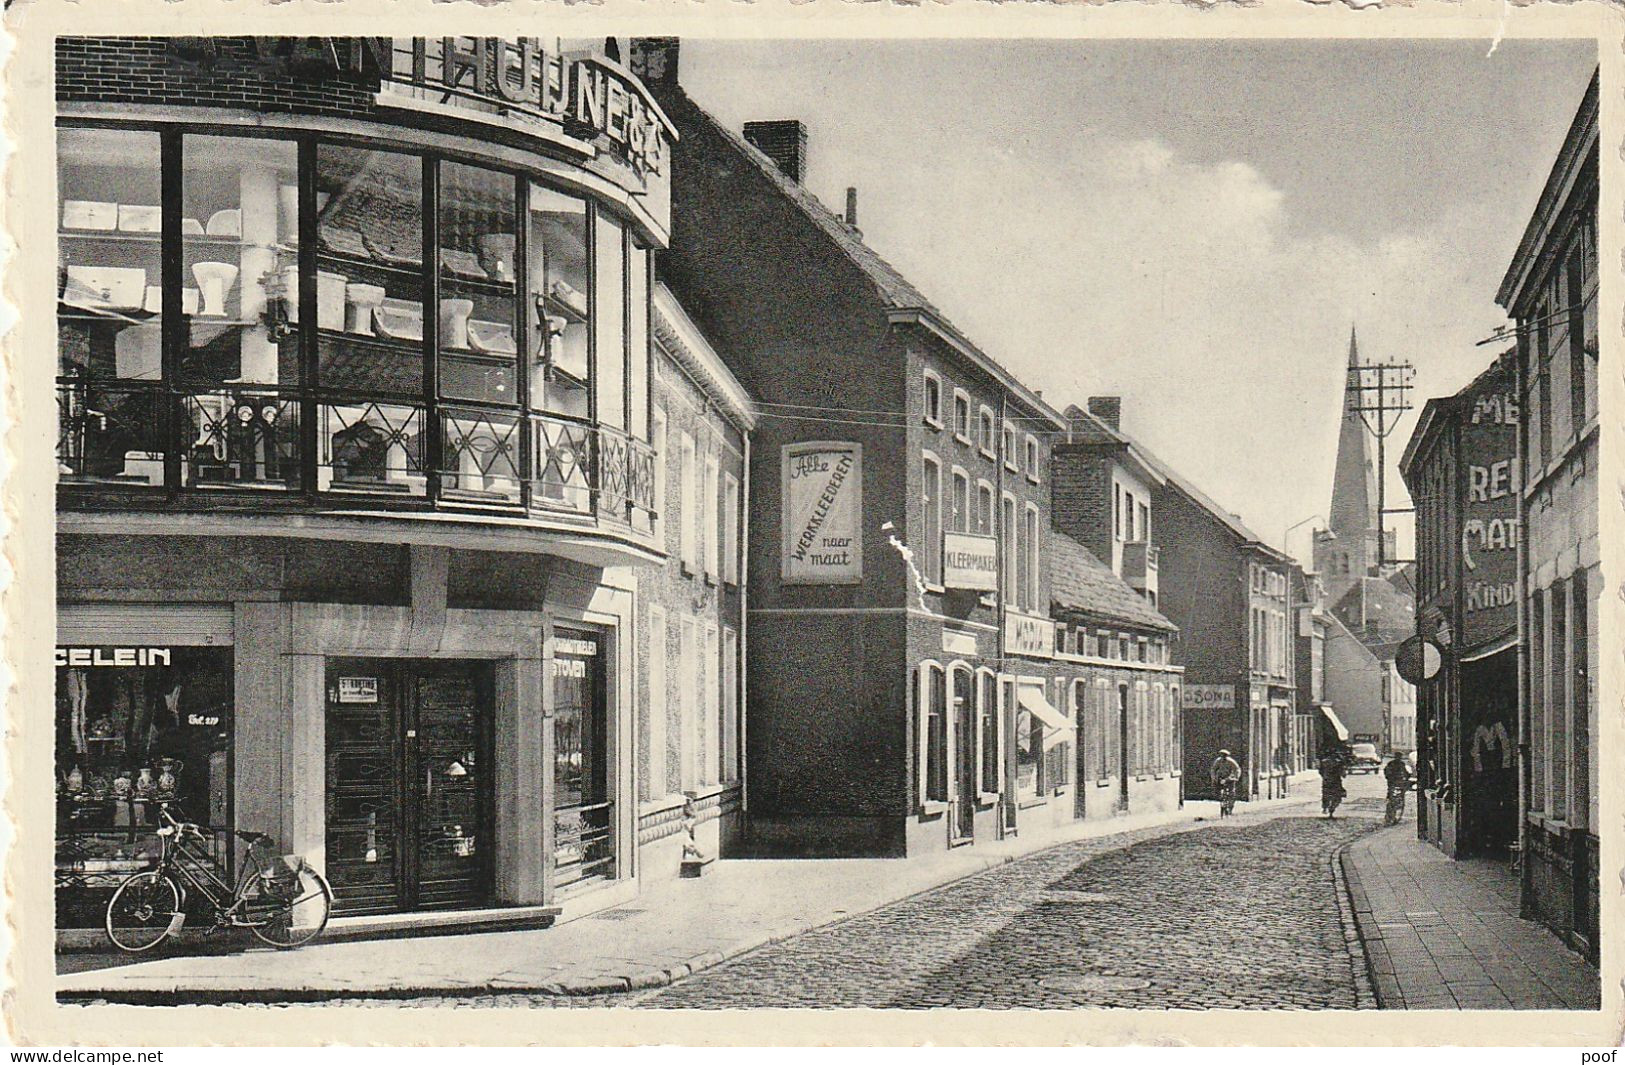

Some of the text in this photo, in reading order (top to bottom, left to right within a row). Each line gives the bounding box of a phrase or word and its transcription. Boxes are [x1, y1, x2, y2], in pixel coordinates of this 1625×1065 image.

[791, 455, 829, 480] Alle
[791, 455, 853, 562] WERKKLEEDEREN
[822, 537, 852, 548] naar
[809, 551, 851, 566] maat
